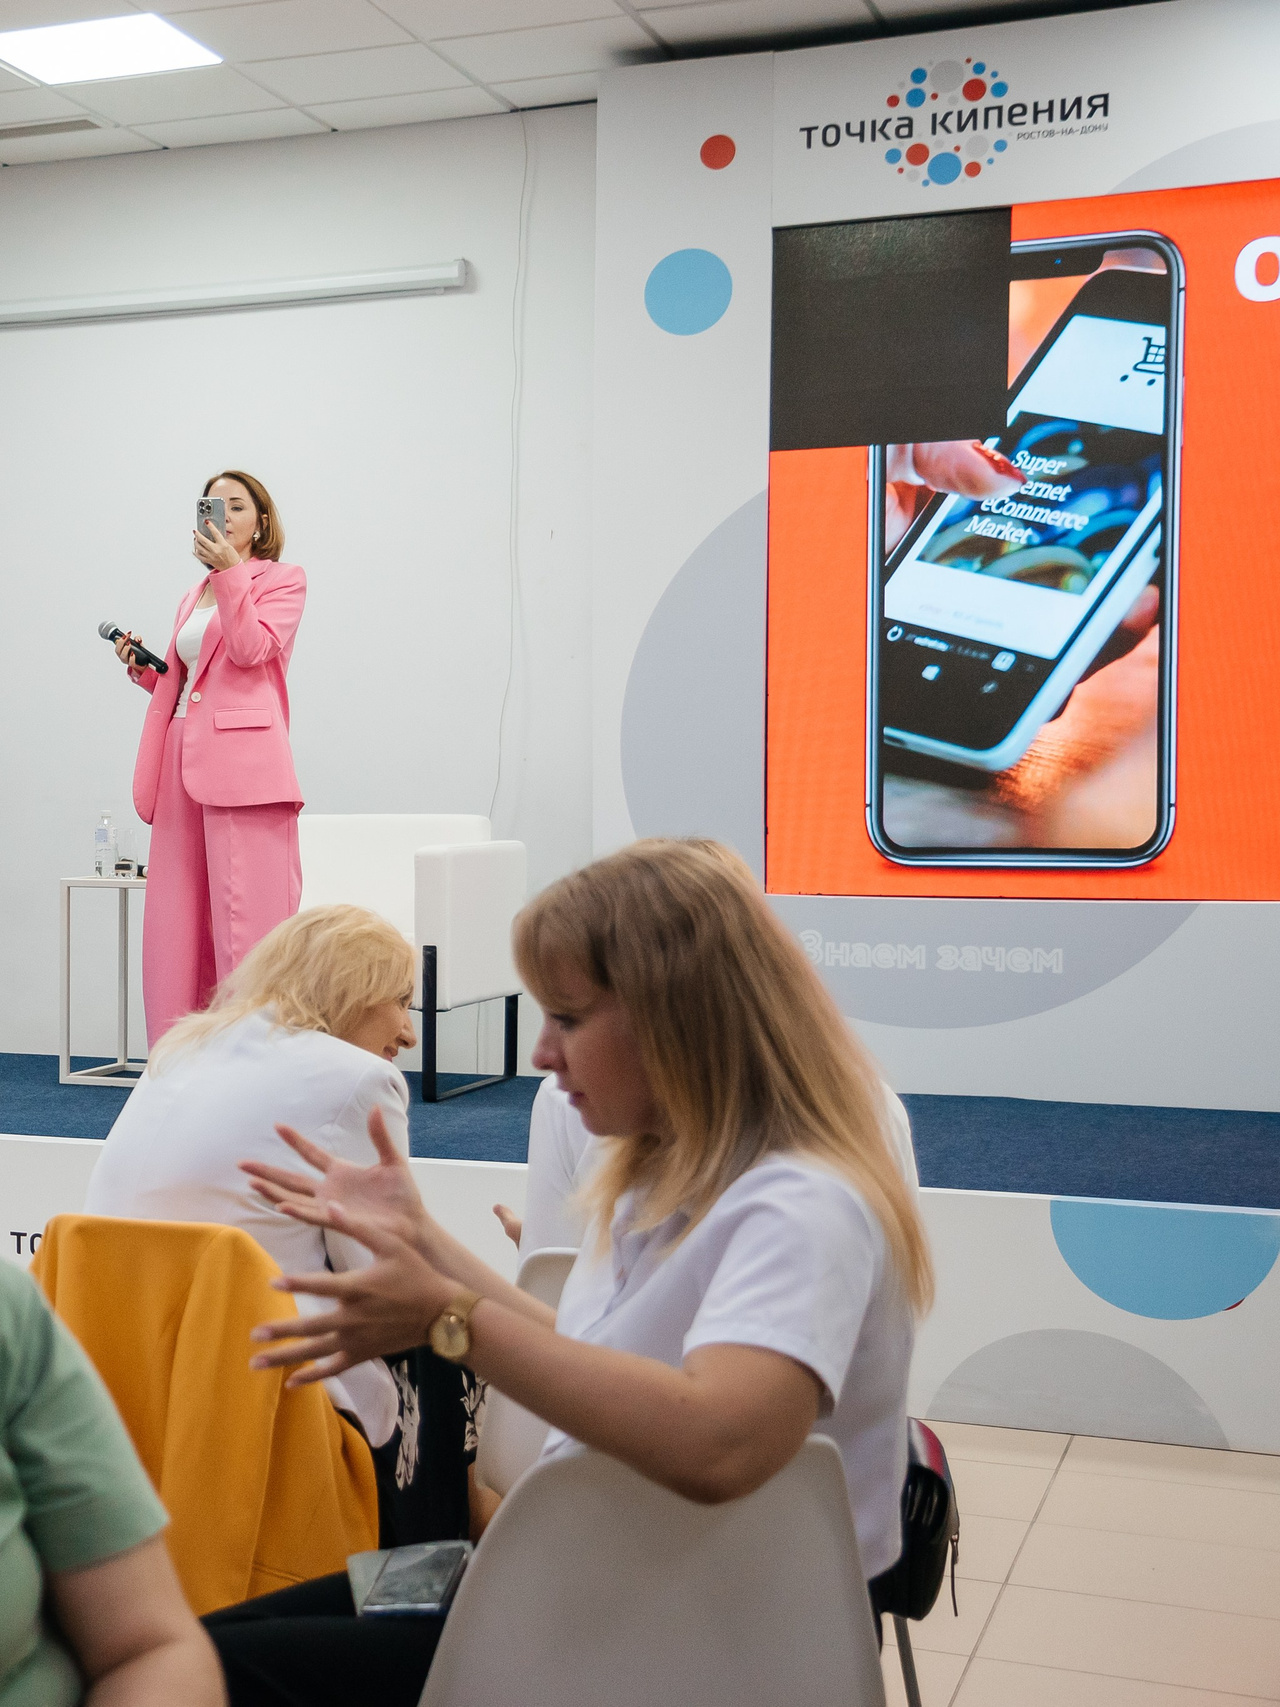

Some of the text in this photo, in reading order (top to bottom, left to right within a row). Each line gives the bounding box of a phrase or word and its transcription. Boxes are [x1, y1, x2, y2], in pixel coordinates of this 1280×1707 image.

[1016, 123, 1109, 141] РОСТОВ-НА-ДОНУ
[1011, 450, 1067, 476] Super
[1019, 479, 1072, 502] ernet
[980, 496, 1090, 532] eCommerce
[964, 514, 1034, 545] Market
[799, 929, 1064, 975] Знаем зачем
